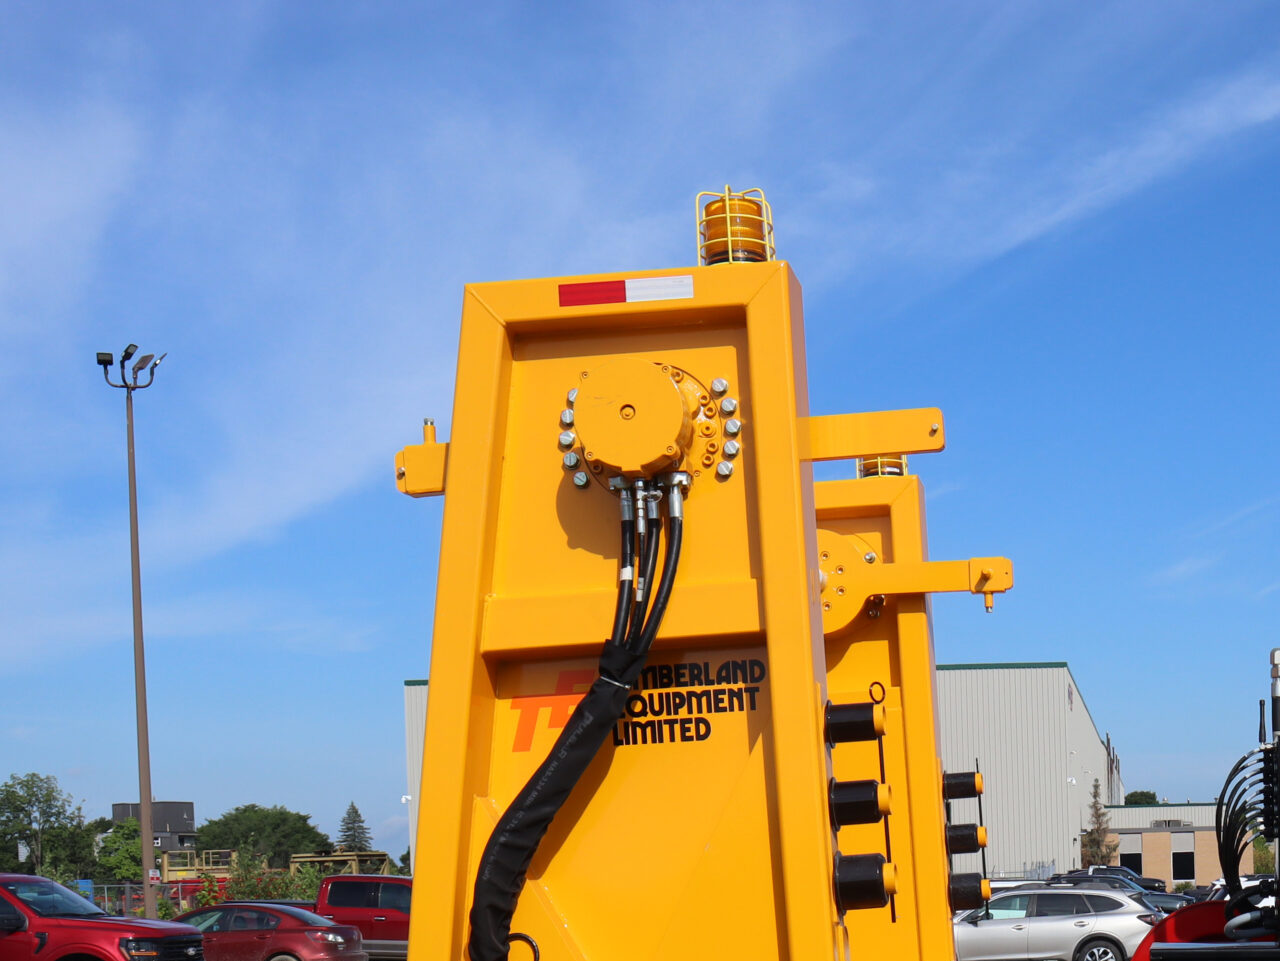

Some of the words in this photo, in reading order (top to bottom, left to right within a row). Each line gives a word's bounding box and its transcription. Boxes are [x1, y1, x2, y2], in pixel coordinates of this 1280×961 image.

[633, 659, 766, 690] MBERLAND
[619, 687, 760, 719] QUIPMENT
[612, 717, 711, 747] LIMITED
